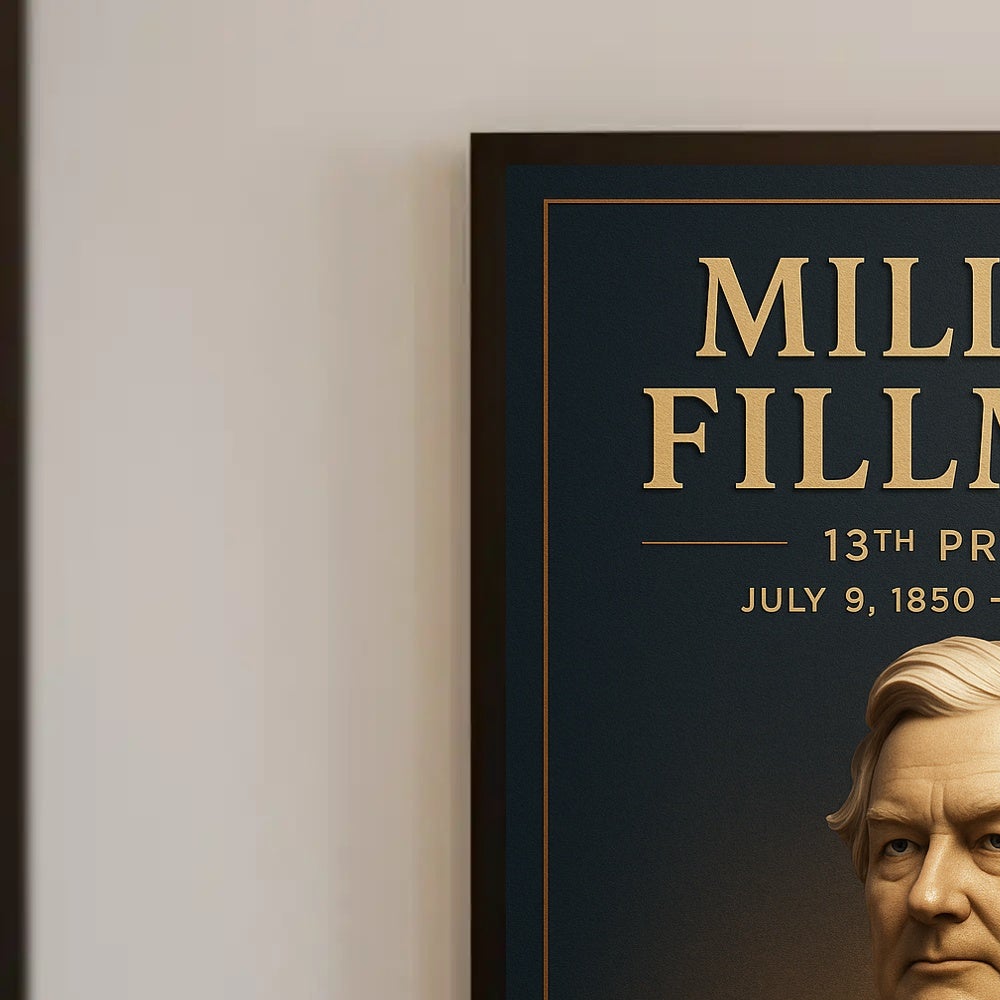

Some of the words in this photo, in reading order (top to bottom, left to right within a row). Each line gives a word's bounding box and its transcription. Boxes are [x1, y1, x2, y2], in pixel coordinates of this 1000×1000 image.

[824, 528, 915, 562] 13TH
[740, 587, 827, 613] JULY
[845, 586, 876, 618] 9,
[891, 586, 975, 613] 1850
